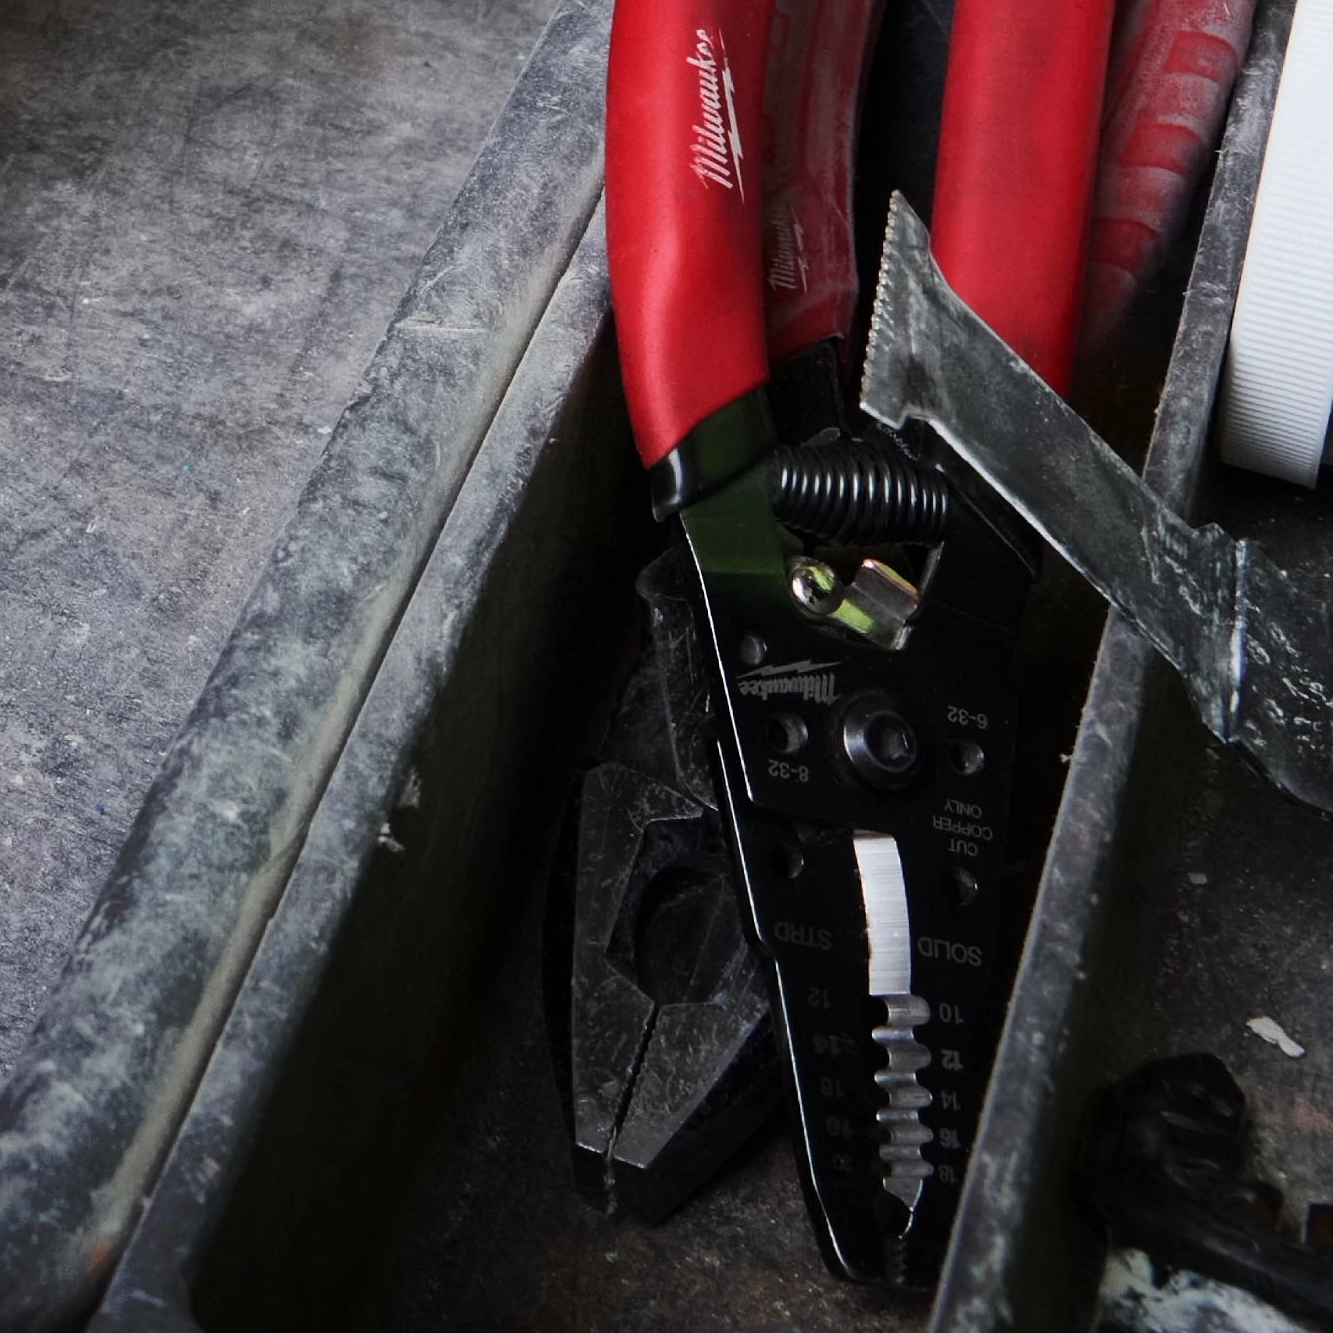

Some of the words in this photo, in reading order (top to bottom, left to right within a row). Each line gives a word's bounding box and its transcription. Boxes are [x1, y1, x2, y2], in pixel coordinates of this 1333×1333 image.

[685, 27, 734, 190] Milwaukee
[737, 671, 842, 707] Milwaukee
[946, 704, 989, 731] 6-32
[766, 758, 810, 784] 8-32
[943, 797, 983, 820] ONLY
[932, 814, 994, 842] COPPER
[946, 838, 979, 857] CUT
[773, 920, 834, 951] STRD
[916, 935, 984, 968] SOLID
[938, 1002, 965, 1026] 10
[939, 1048, 964, 1071] 12
